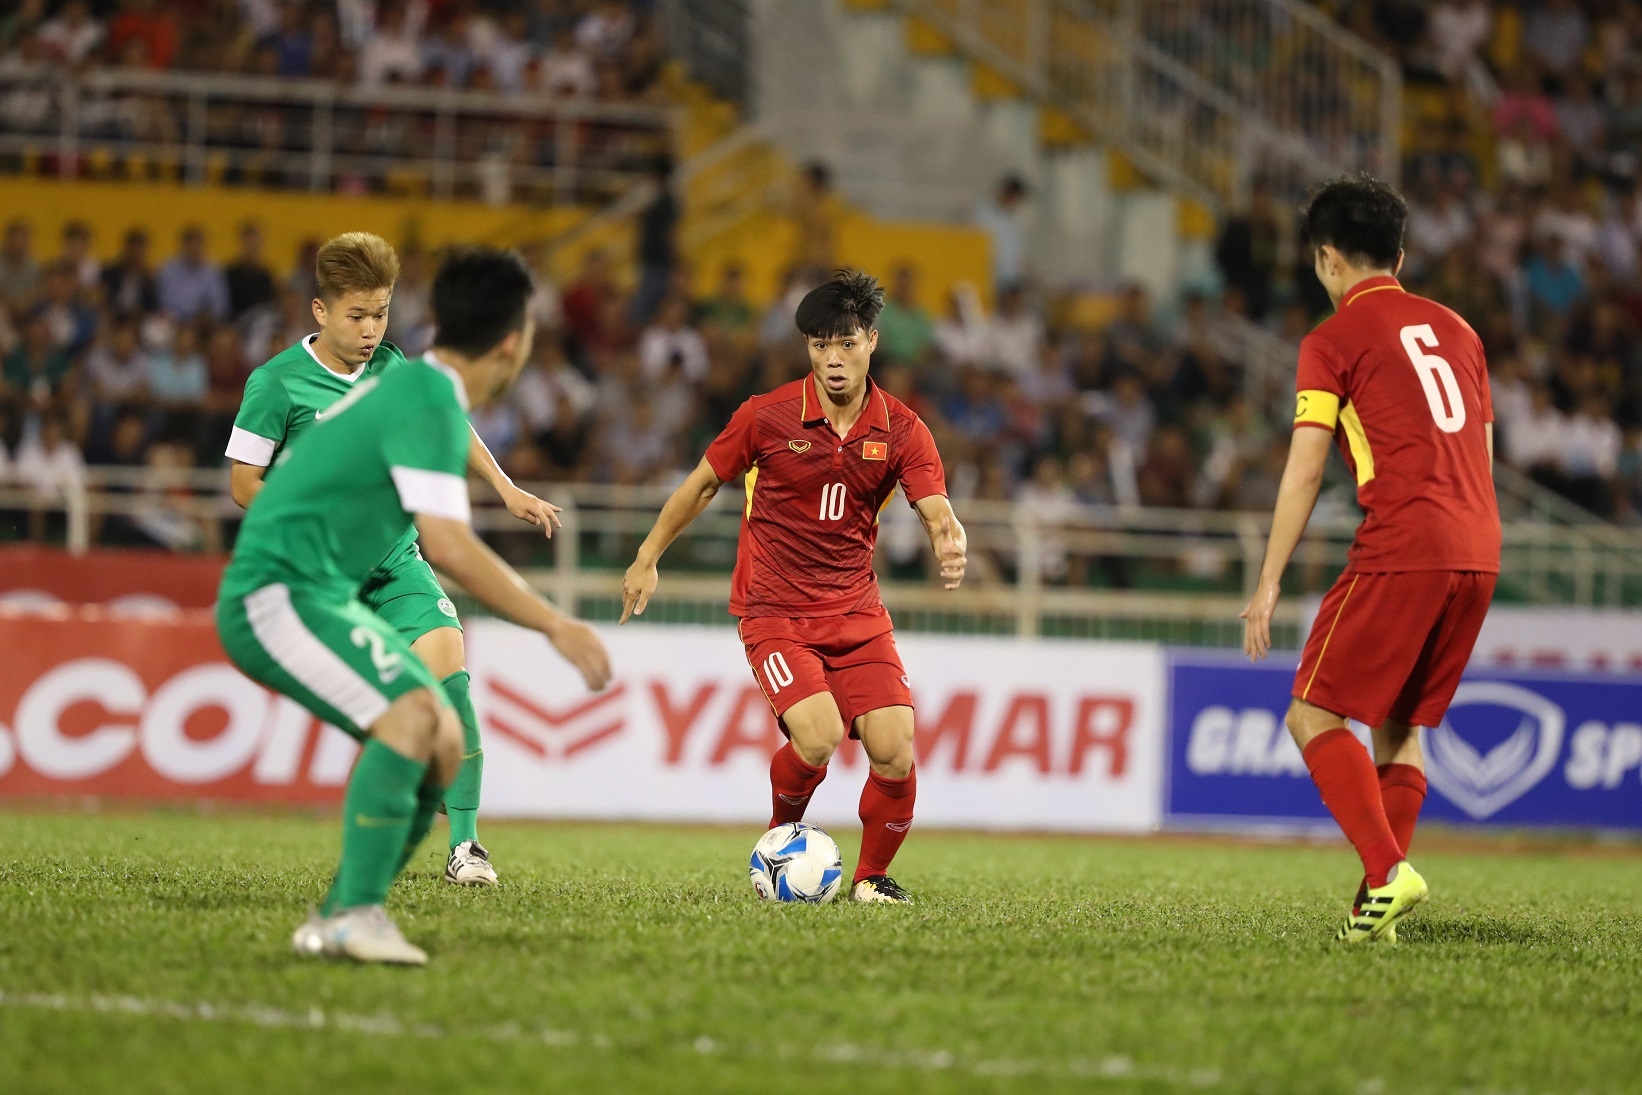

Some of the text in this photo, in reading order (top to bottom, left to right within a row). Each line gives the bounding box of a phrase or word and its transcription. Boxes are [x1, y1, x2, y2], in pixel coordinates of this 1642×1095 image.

[1296, 396, 1308, 418] C
[1400, 324, 1466, 433] 6
[819, 482, 847, 521] 10
[763, 651, 794, 695] 10
[648, 681, 1137, 779] YAMAR
[1564, 719, 1642, 791] SP
